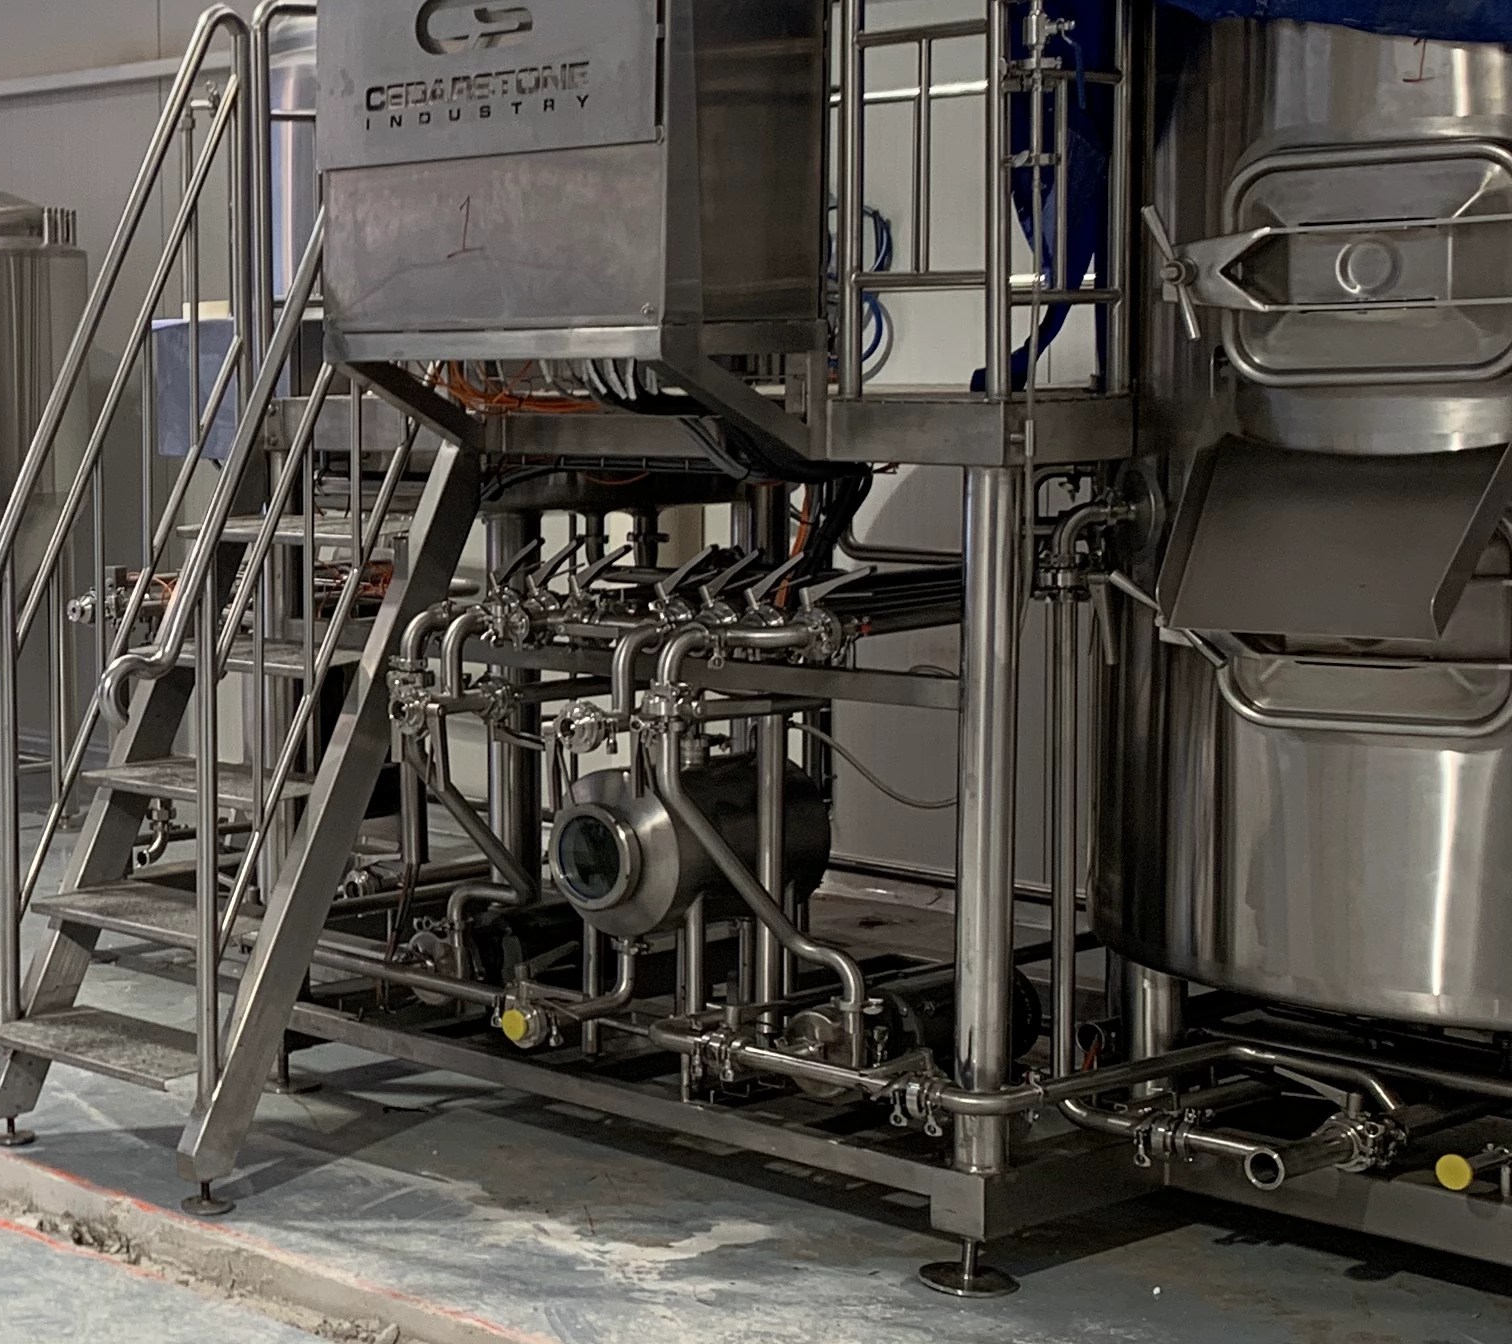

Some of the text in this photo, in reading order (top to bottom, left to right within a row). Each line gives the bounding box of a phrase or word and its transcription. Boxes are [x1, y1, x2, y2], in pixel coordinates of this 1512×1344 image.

[365, 61, 590, 112] CEDARSTONE
[365, 95, 589, 130] INDUSTRY
[447, 196, 484, 259] 1
